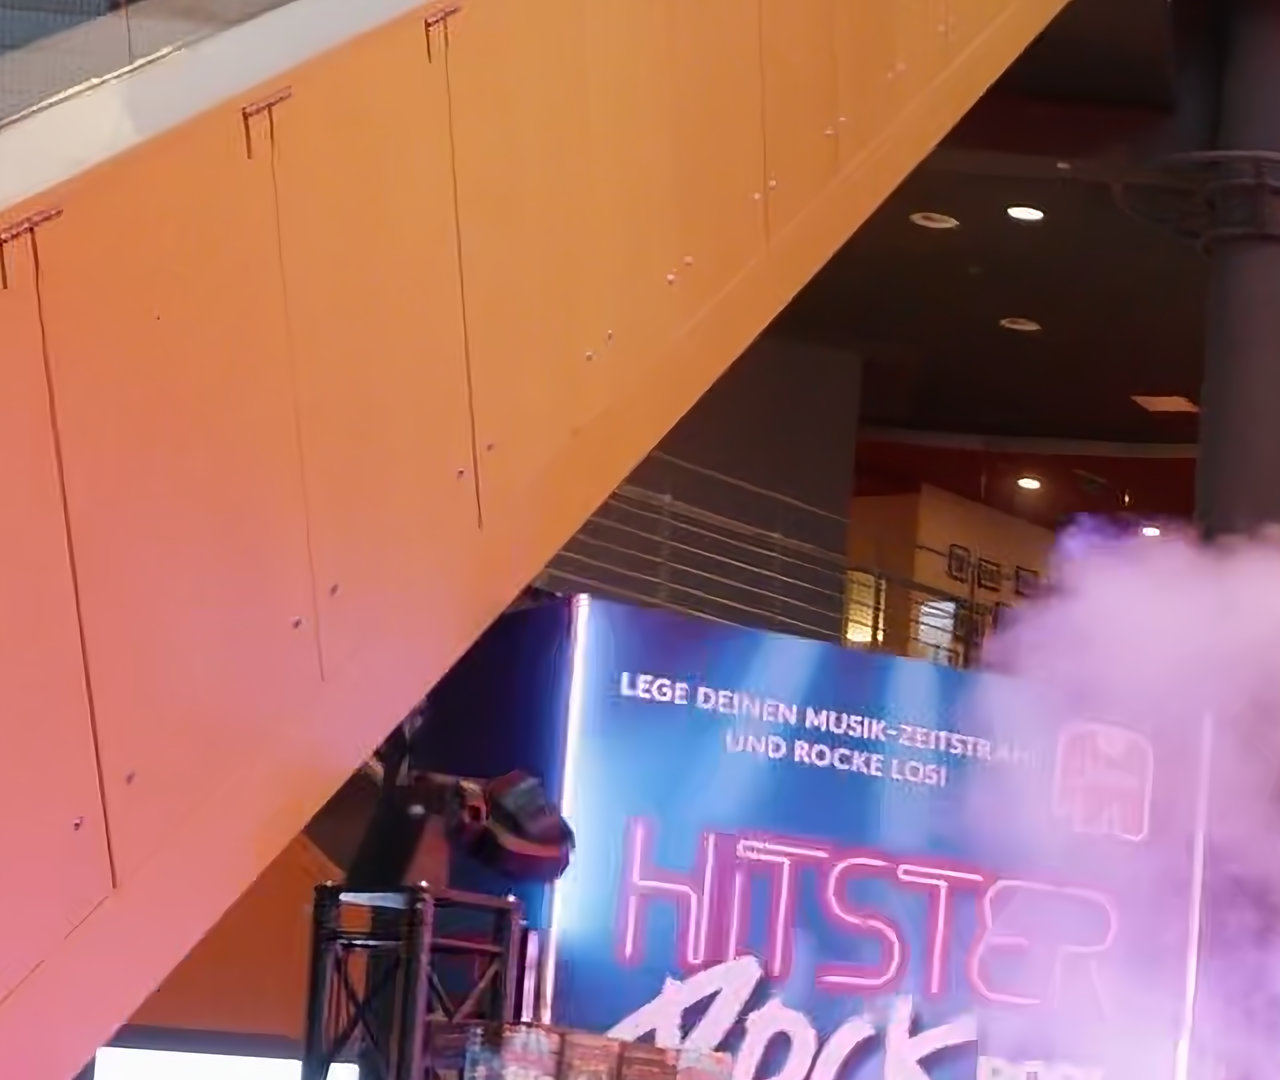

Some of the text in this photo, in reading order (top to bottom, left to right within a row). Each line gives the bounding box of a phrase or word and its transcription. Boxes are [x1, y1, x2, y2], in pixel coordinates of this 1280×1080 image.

[620, 671, 689, 705] LEGE
[697, 685, 798, 725] DEINEN
[725, 730, 787, 760] UND
[793, 738, 884, 778] ROCKE
[618, 815, 1120, 1012] HITSTER
